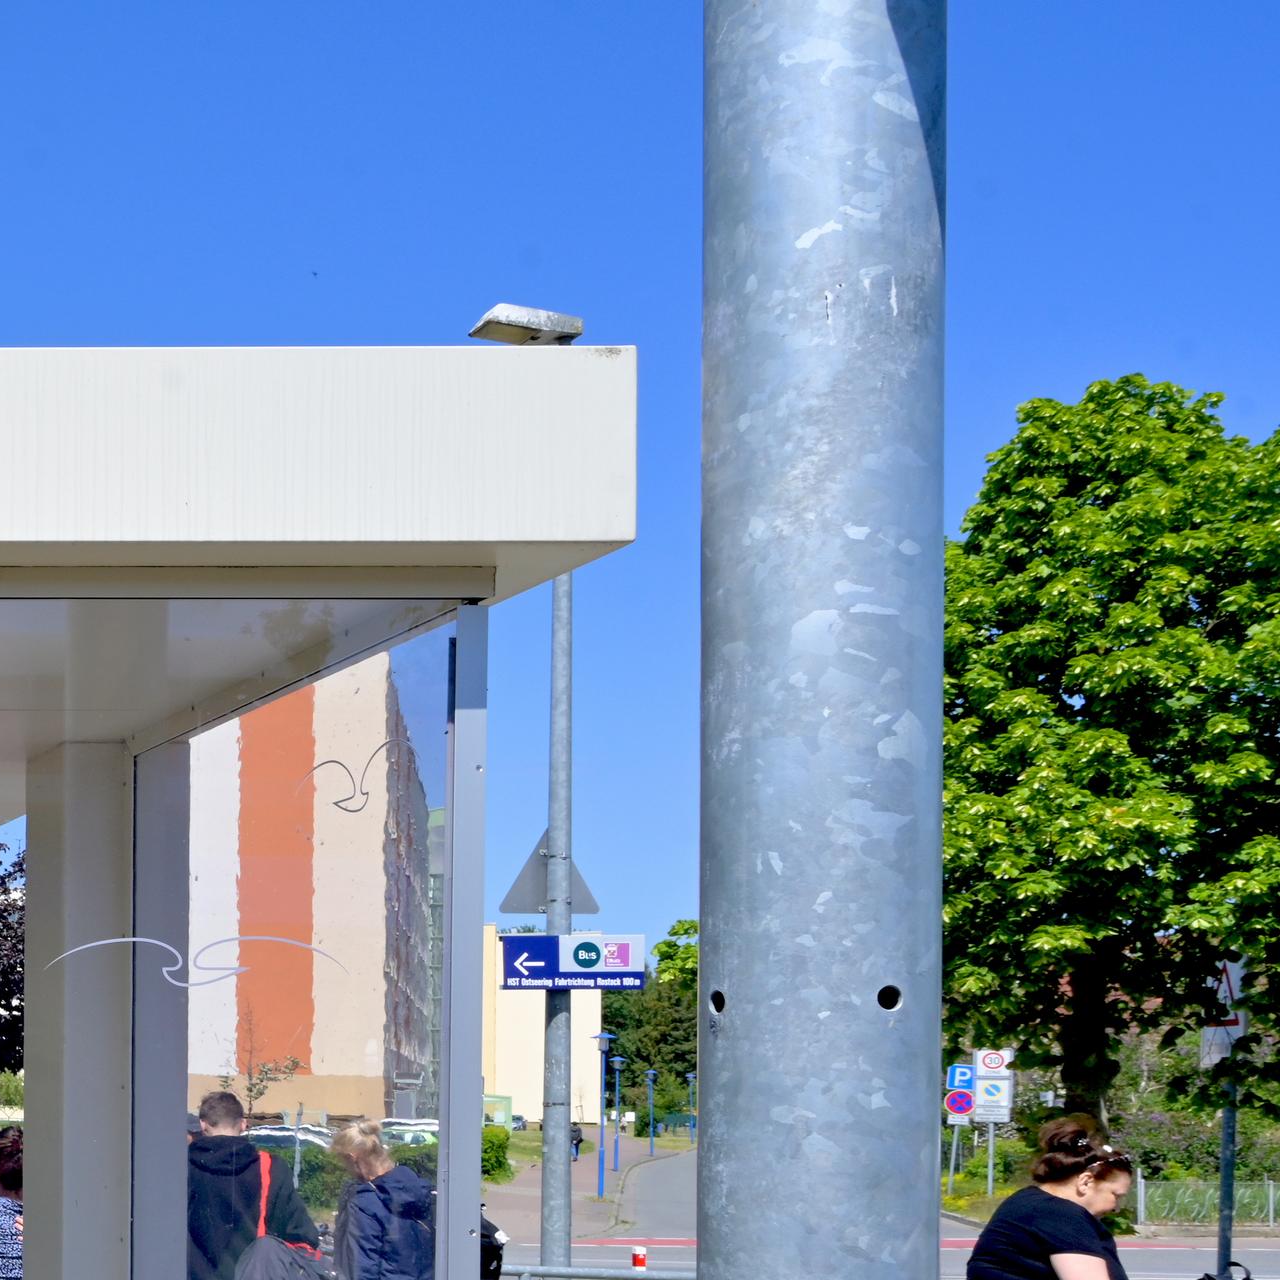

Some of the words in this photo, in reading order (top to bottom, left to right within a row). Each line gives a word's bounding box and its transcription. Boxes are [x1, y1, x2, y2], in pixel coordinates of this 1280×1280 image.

[578, 950, 597, 960] Bus
[555, 977, 595, 987] Fahrtrichtung
[987, 1057, 1000, 1065] 30
[954, 1067, 972, 1087] P
